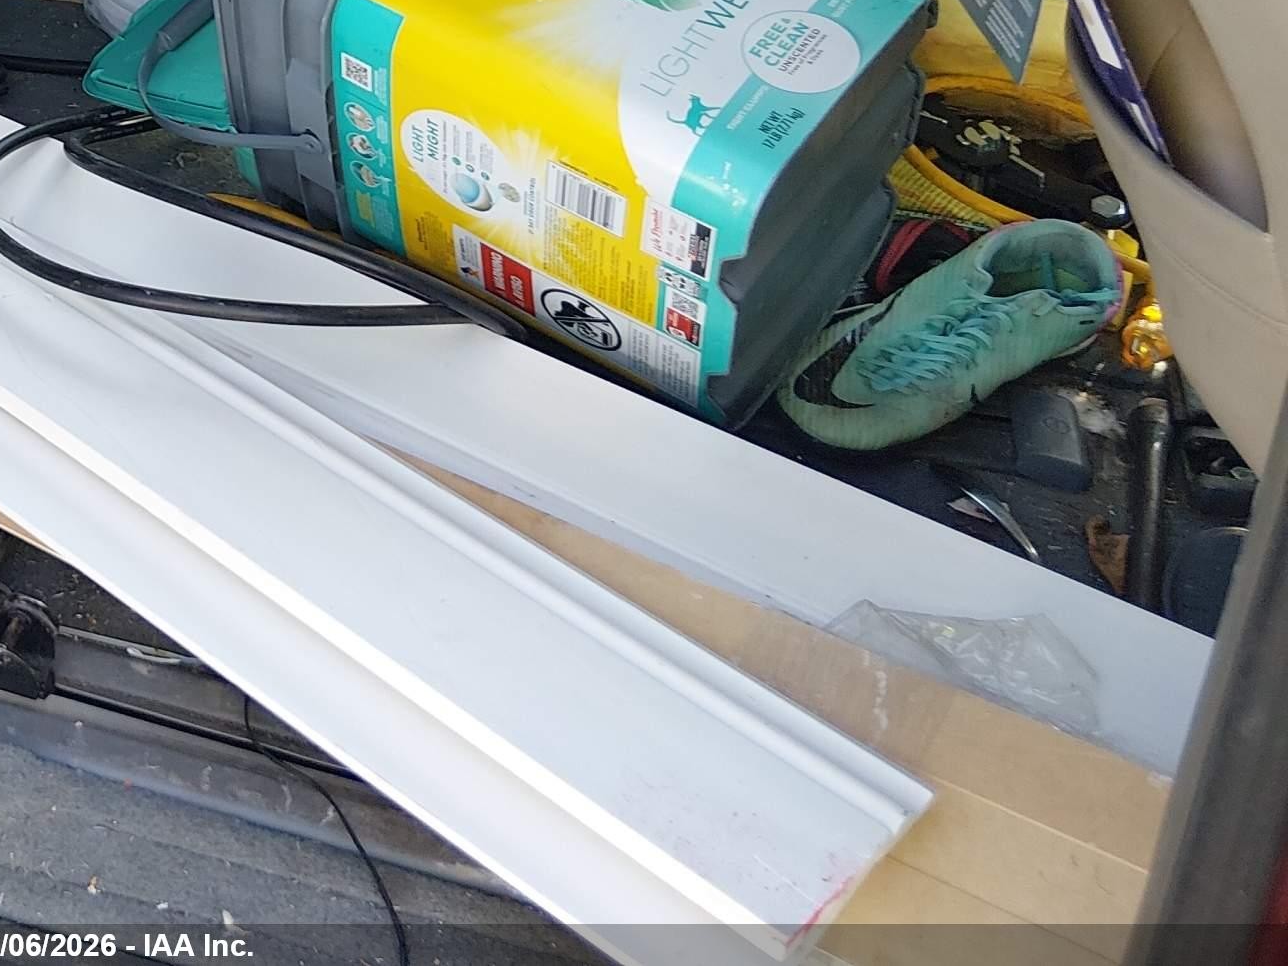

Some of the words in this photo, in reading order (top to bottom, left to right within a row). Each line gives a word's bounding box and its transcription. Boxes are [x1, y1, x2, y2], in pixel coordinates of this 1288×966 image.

[749, 22, 785, 59] FREE
[764, 22, 809, 67] CLEAN
[778, 28, 821, 72] UNSCENTED
[427, 118, 440, 160] MIGHT
[758, 120, 774, 134] NET
[766, 110, 782, 123] WT
[411, 125, 424, 162] LIGHT
